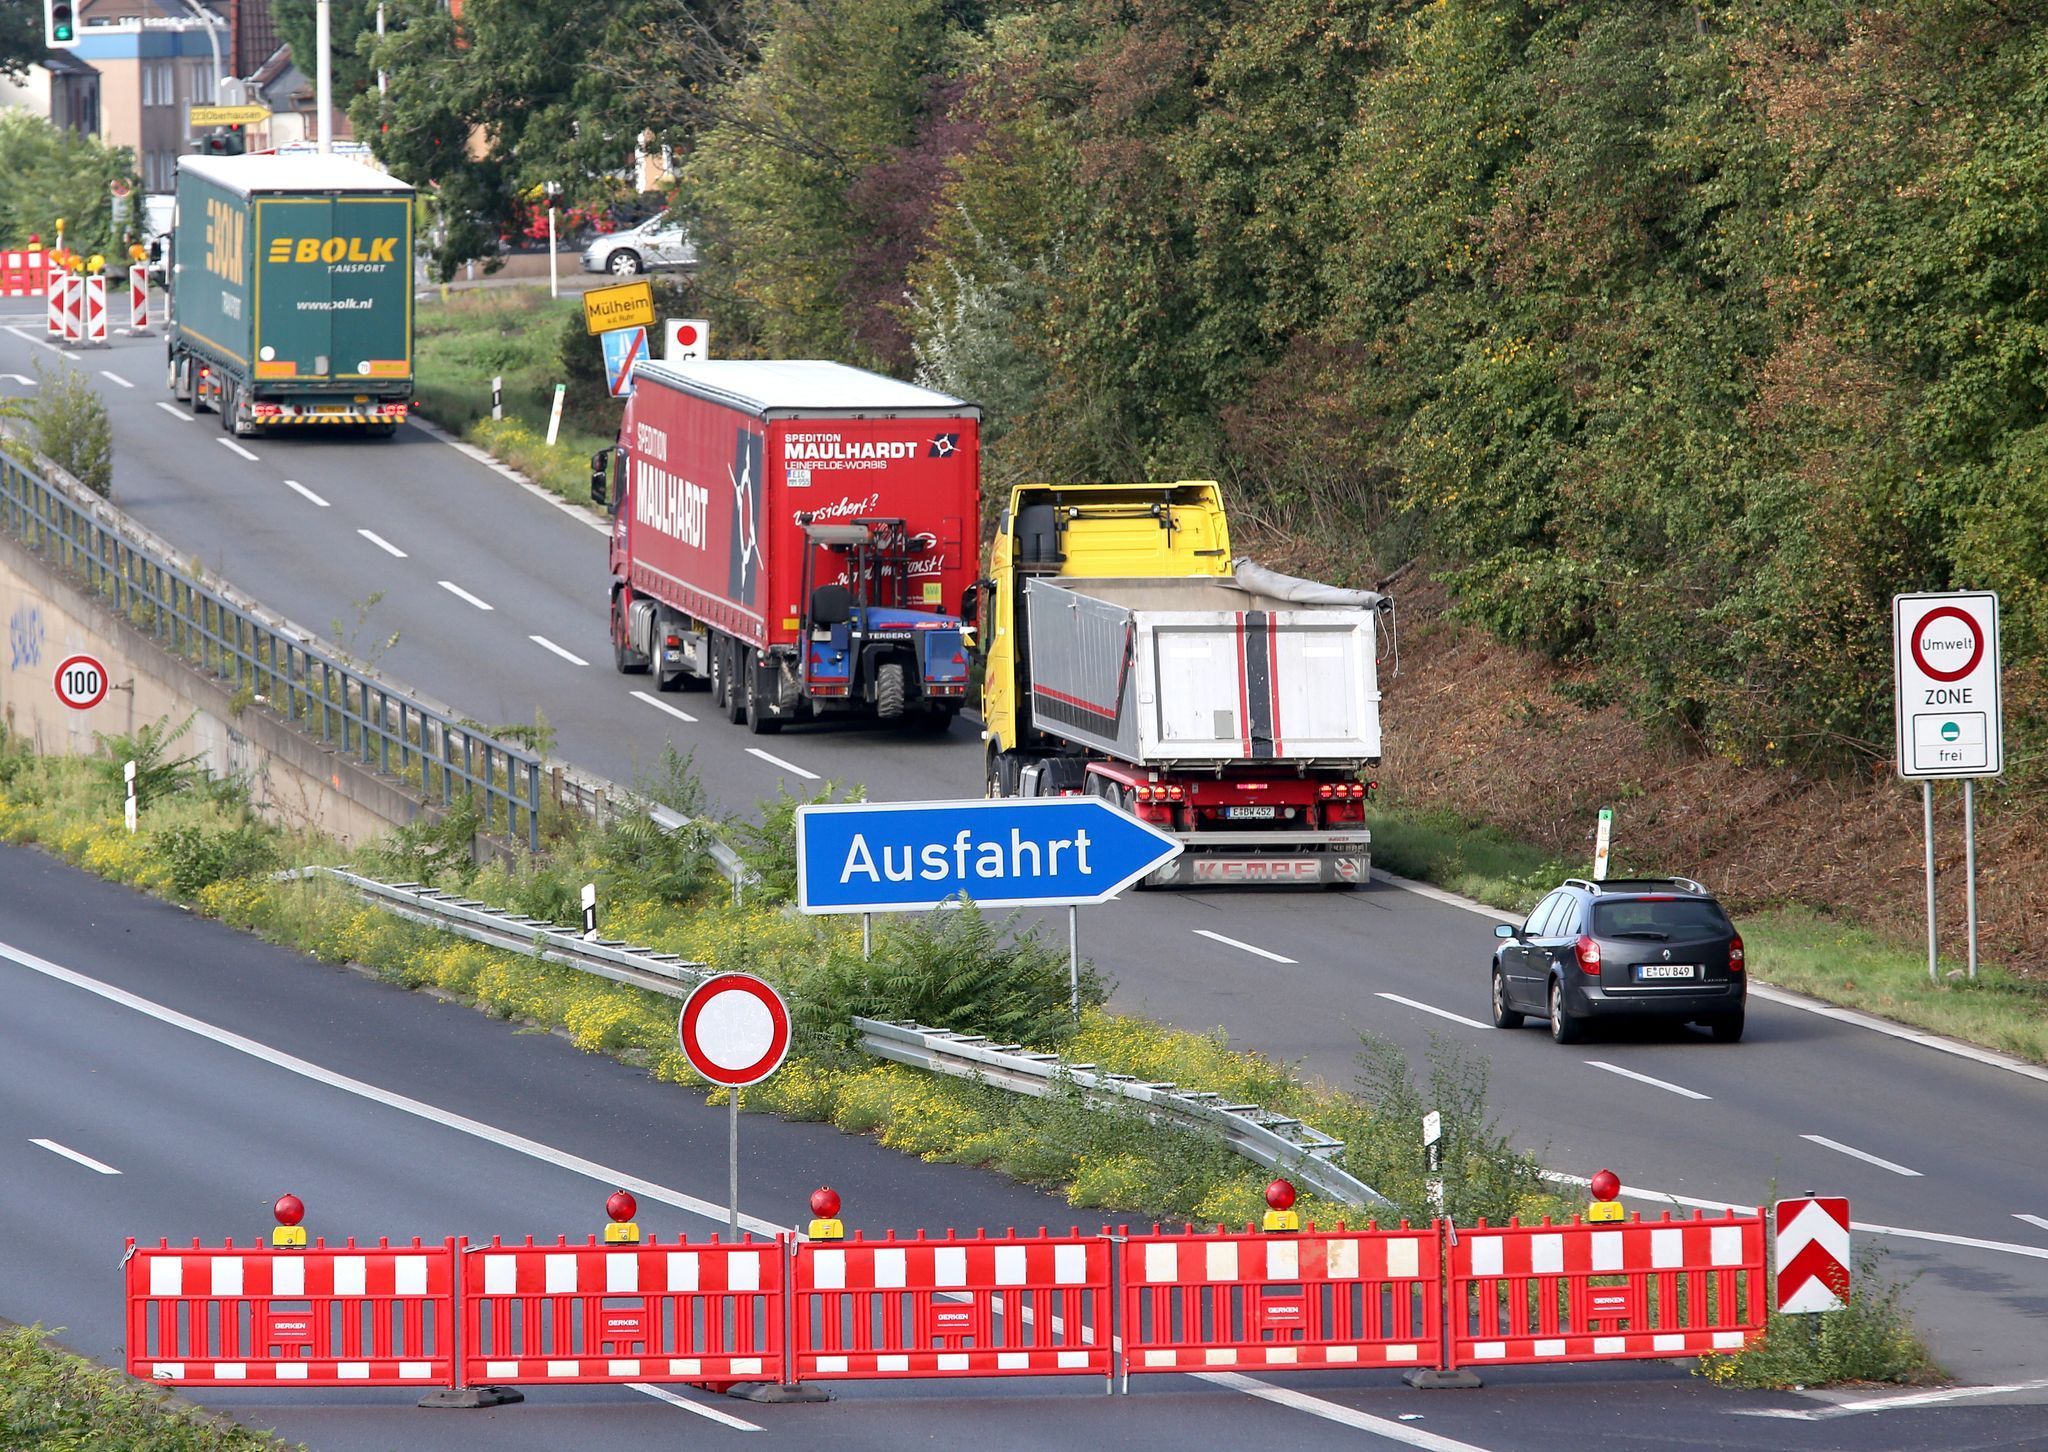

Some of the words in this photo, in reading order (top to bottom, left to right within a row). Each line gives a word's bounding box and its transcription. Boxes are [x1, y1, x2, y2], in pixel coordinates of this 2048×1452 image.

[295, 237, 399, 263] BOLK
[588, 297, 649, 317] Mülheim
[785, 433, 841, 443] SPEDITION
[784, 442, 918, 459] MAULHARDT
[784, 460, 888, 470] LEINEFELDE-WORBIS
[637, 459, 709, 551] MAULHARDT
[868, 632, 912, 640] TERBERG
[1922, 638, 1972, 650] Umwelt
[65, 670, 98, 695] 100
[1925, 688, 1973, 705] ZONE
[1939, 749, 1963, 762] frei
[839, 827, 1092, 884] Ausfahrt
[1199, 862, 1316, 880] KEMPF
[1672, 967, 1690, 976] 849
